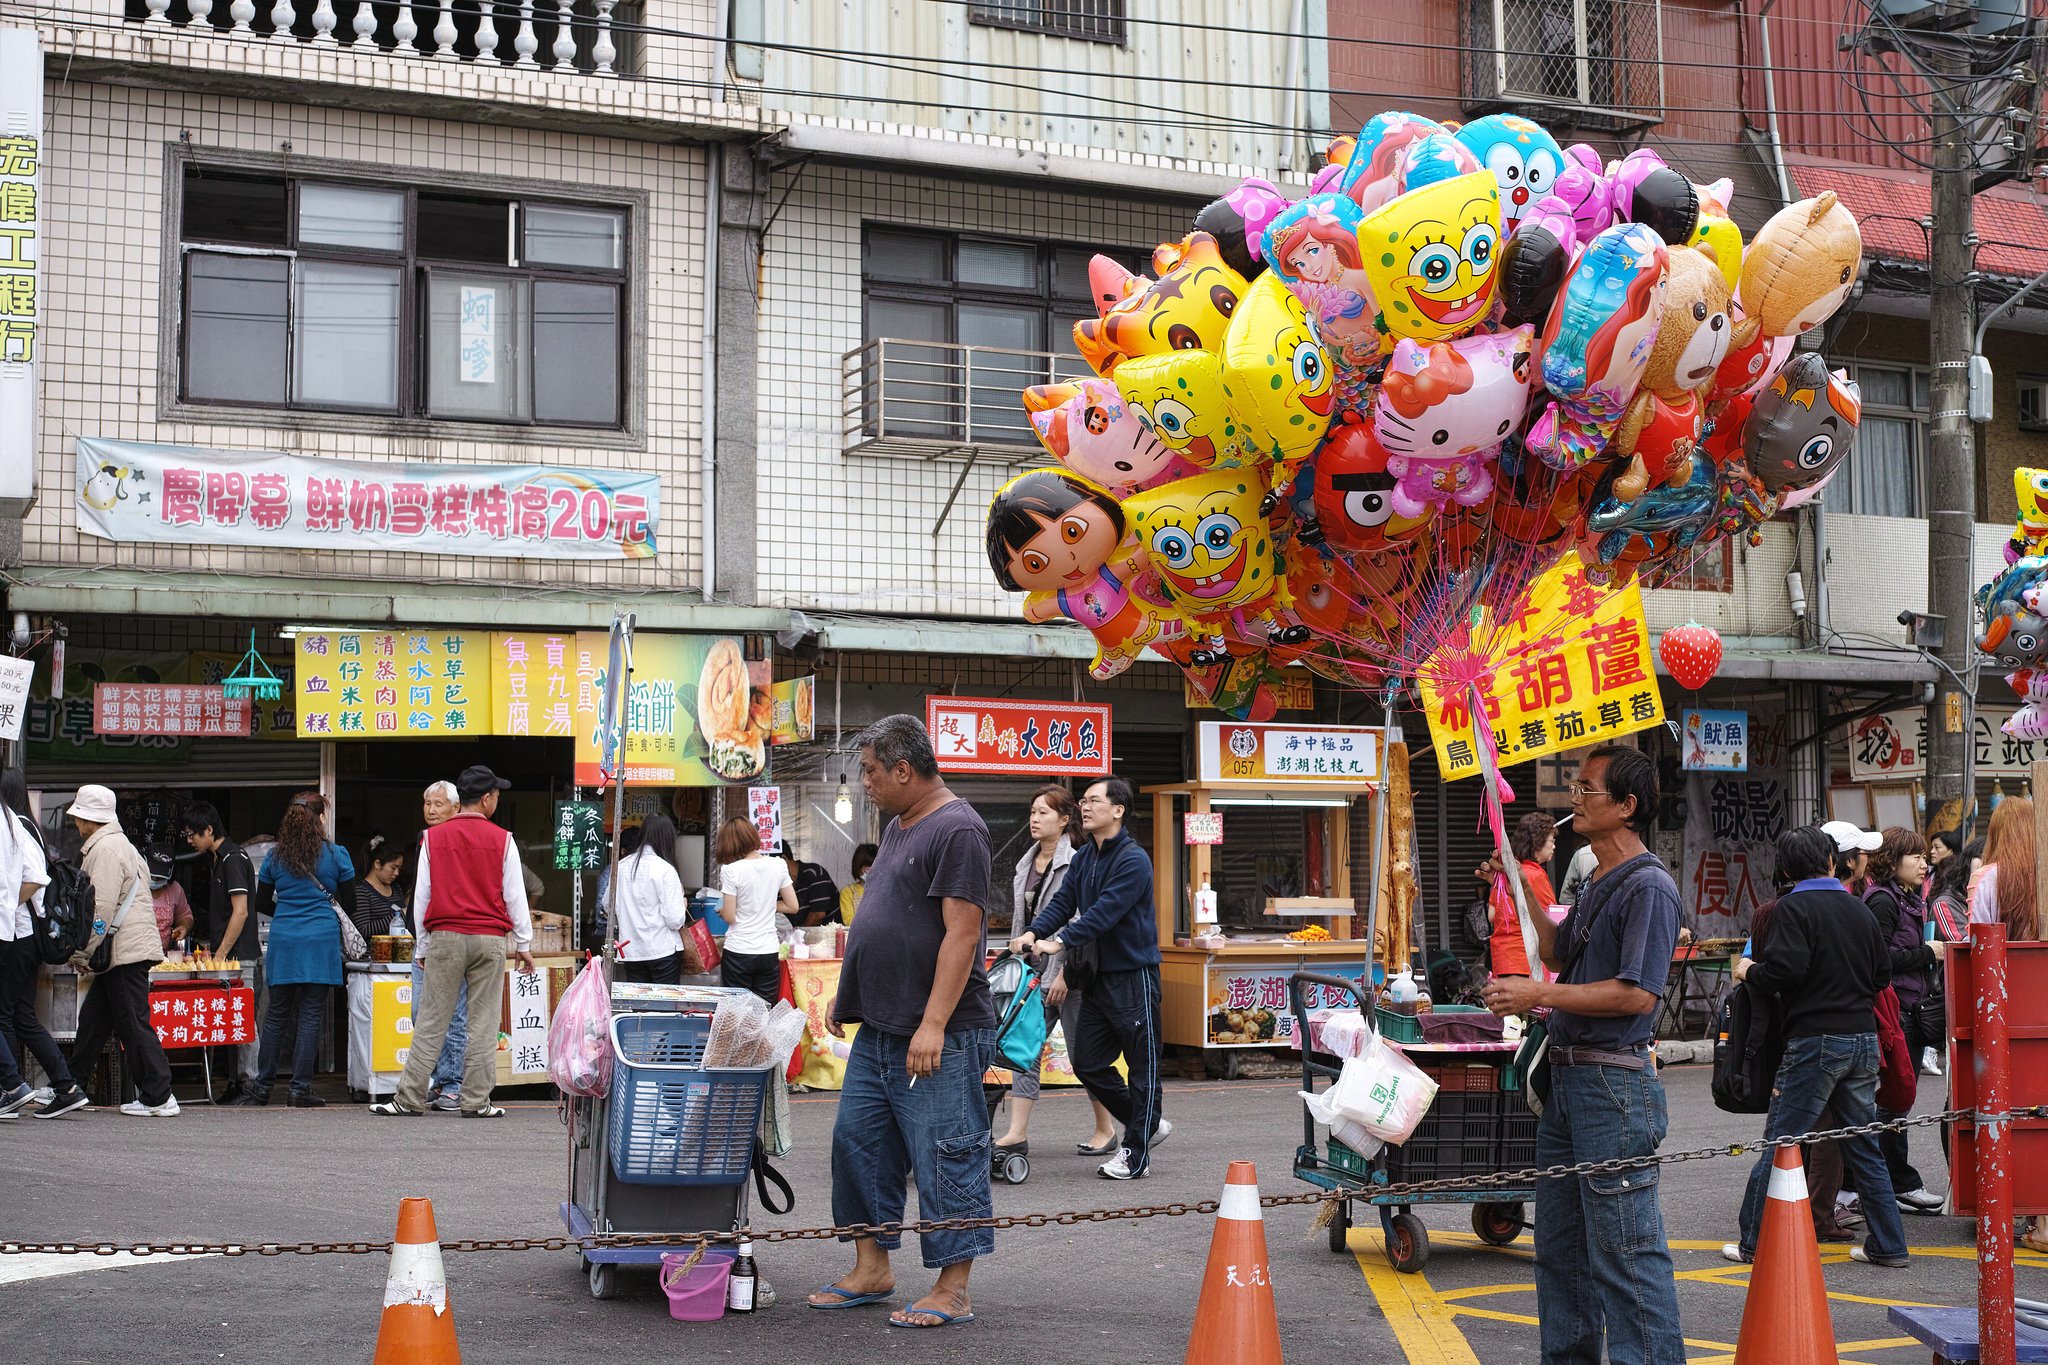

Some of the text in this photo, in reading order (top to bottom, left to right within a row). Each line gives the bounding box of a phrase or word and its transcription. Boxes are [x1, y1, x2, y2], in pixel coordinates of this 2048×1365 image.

[0, 136, 37, 362] 宏偉工程行
[160, 467, 651, 544] 慶開幕 鮮奶雪糕特價20元
[303, 636, 332, 734] 豬血糕
[339, 635, 365, 731] 筒仔米糕
[373, 636, 397, 731] 清蒸肉圓
[408, 637, 433, 730] 淡水阿給
[443, 635, 467, 729] 甘草芭樂
[504, 637, 530, 736] 臭豆腐
[544, 637, 571, 736] 貢丸湯
[102, 688, 120, 730] 鮮蚵嗲
[123, 688, 140, 731] 大熱狗
[144, 688, 161, 731] 花枝丸
[163, 688, 181, 732] 糯米腸
[184, 689, 201, 732] 芋頭餅
[204, 690, 222, 732] 炸地瓜
[940, 714, 1100, 759] 超大 轟炸大魷魚
[1285, 736, 1353, 751] 海中極品
[1704, 721, 1742, 746] 魷魚
[1234, 761, 1254, 774] 057
[1277, 757, 1363, 773] 澎湖花枝丸
[584, 808, 603, 868] 冬瓜茶
[1693, 851, 1761, 917] 侵入
[172, 999, 189, 1042] 熱狗
[192, 998, 208, 1043] 花枝丸
[210, 998, 227, 1042] 糯米腸
[516, 974, 545, 1071] 豬血糕
[1226, 1264, 1271, 1287] 天元
